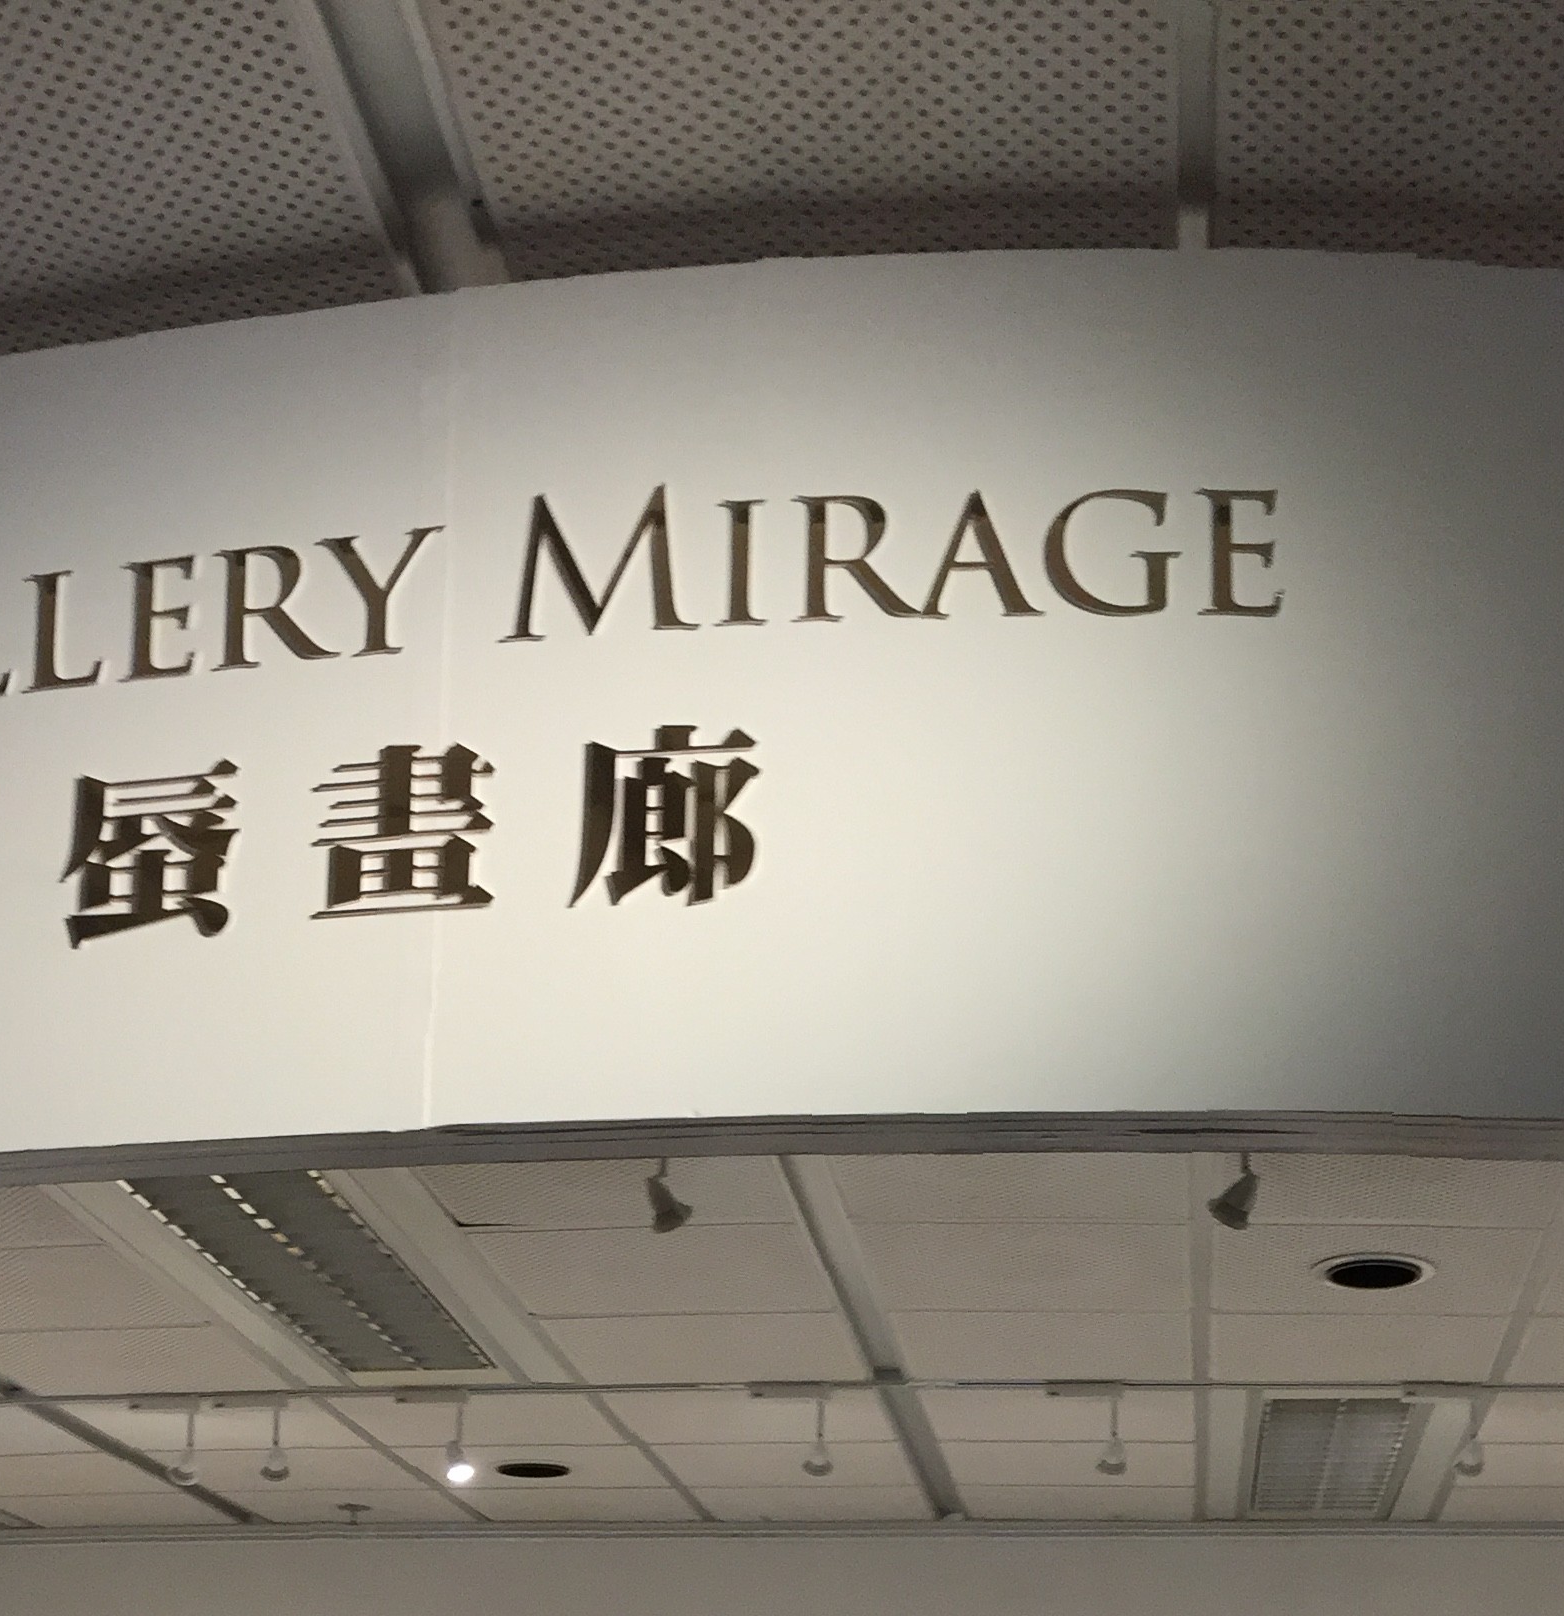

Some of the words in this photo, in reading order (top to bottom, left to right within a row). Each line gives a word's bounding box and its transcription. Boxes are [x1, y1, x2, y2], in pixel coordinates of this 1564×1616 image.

[497, 484, 1285, 644] MIRAGE
[59, 725, 763, 949] 蜃畫廊
